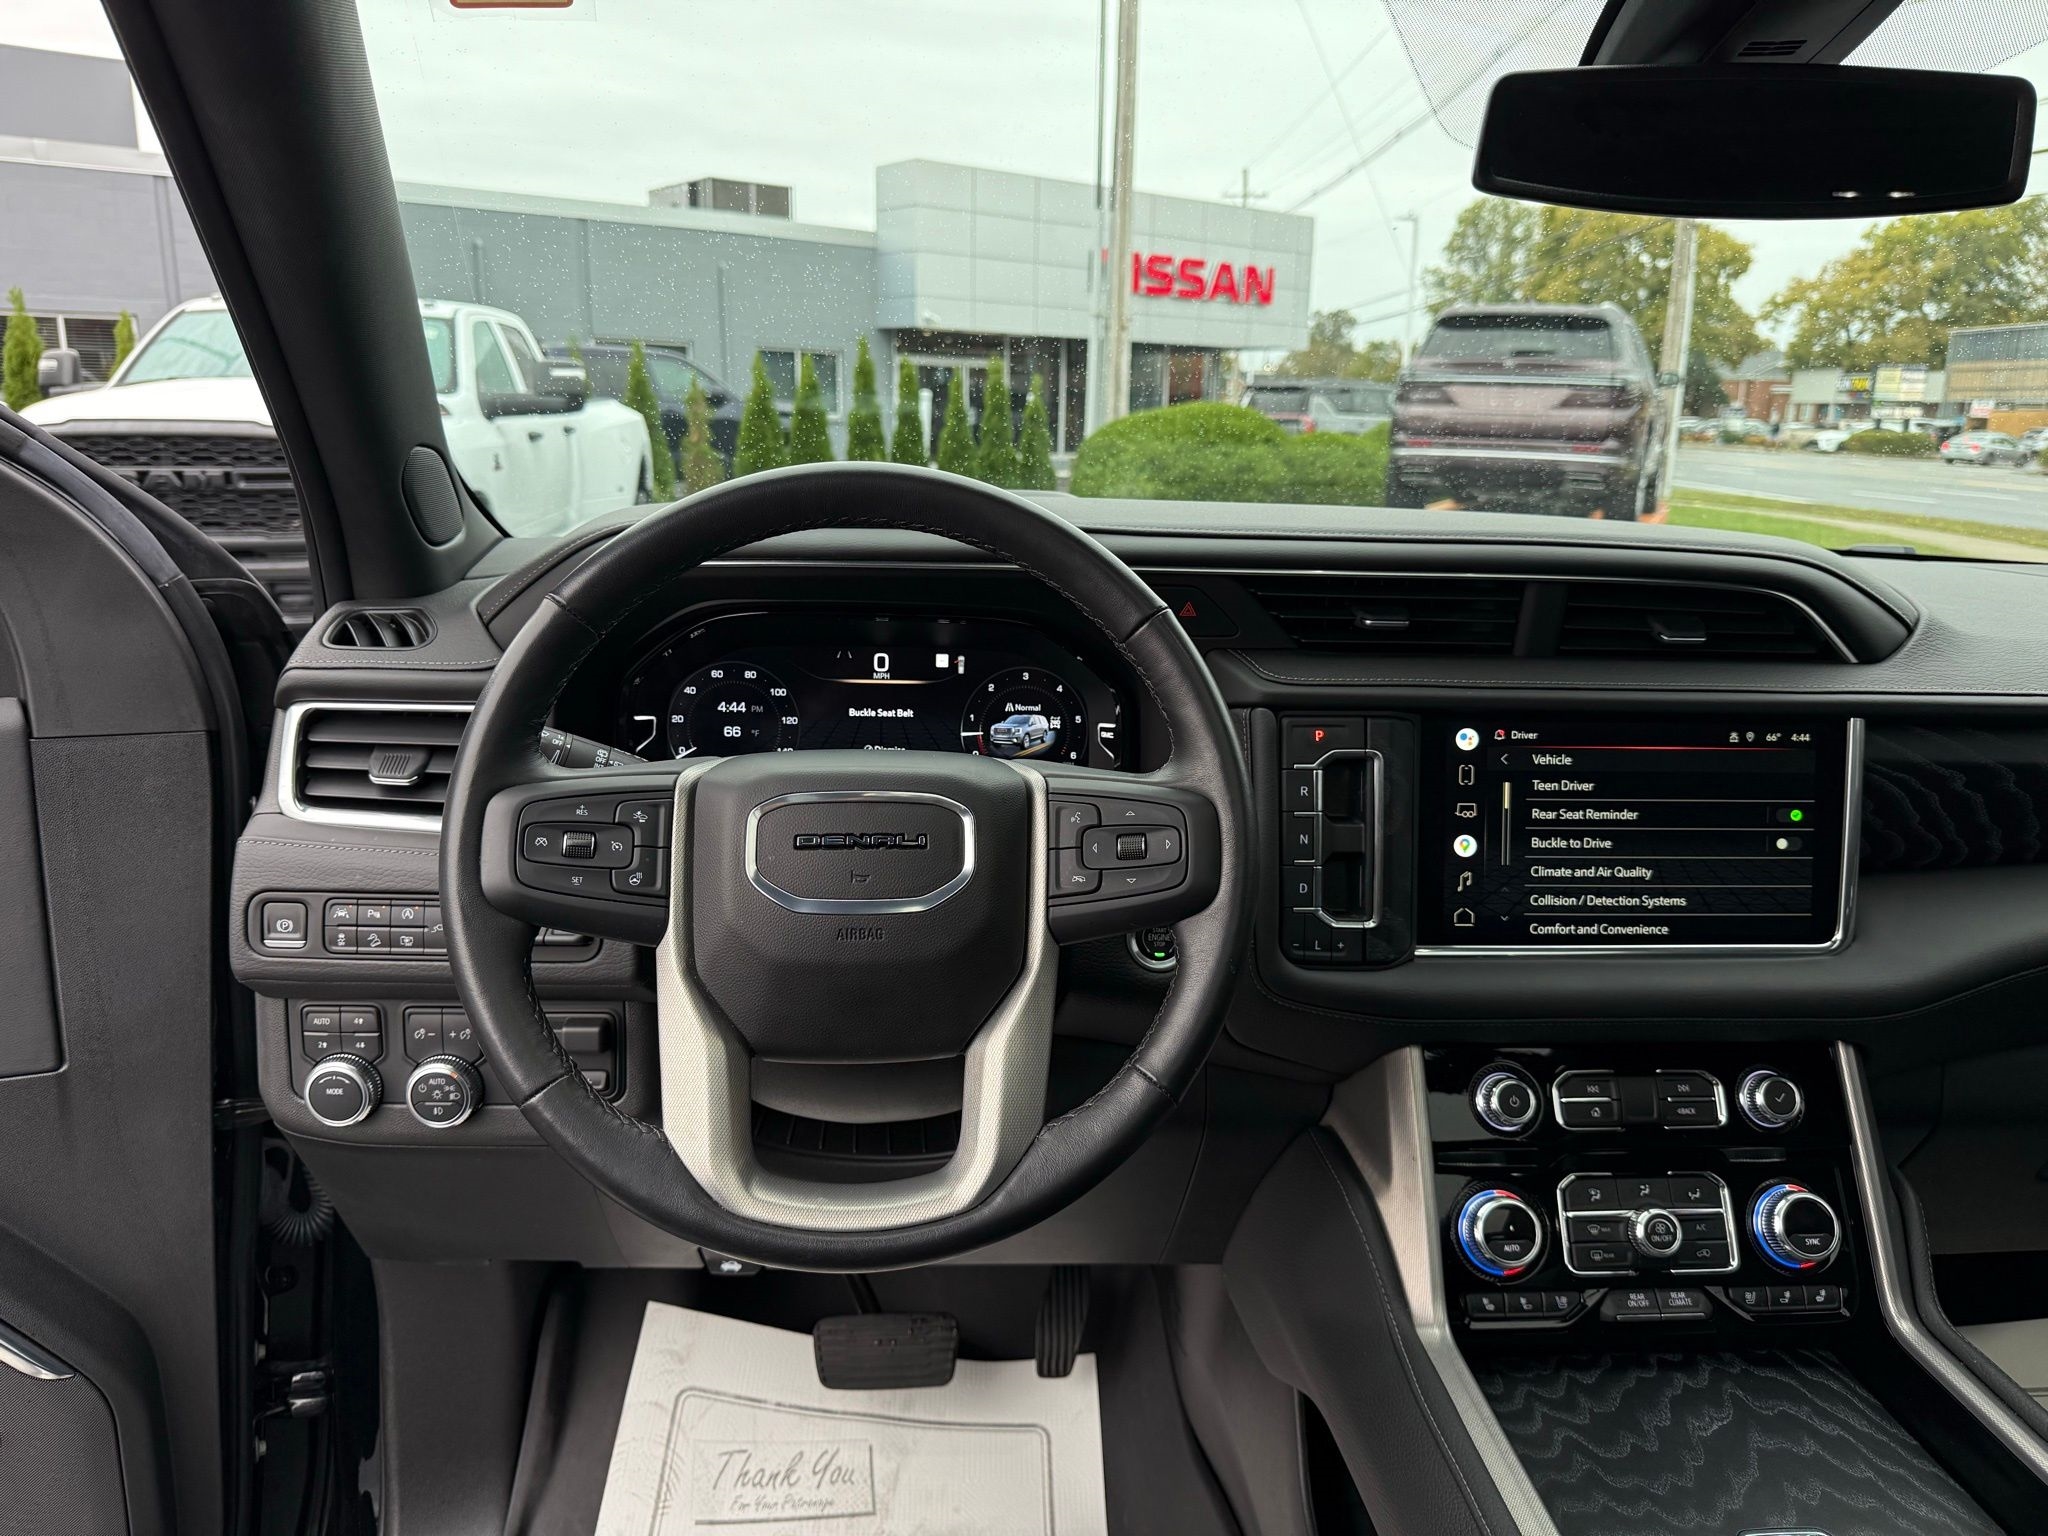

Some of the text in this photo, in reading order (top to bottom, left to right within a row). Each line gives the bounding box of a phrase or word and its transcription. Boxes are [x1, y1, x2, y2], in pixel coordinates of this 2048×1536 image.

[1102, 248, 1275, 305] ISSAN
[874, 652, 890, 672] 0
[711, 670, 724, 678] 60
[744, 670, 757, 679] 80
[873, 672, 890, 680] MPH
[1022, 672, 1029, 680] 3
[684, 686, 696, 694] 40
[770, 688, 787, 696] 100
[988, 684, 994, 692] 2
[1056, 684, 1063, 692] 4
[717, 702, 764, 713] 4:44 PM
[1015, 704, 1041, 712] Normal
[848, 708, 914, 718] Buckle Seat Belt
[970, 714, 974, 722] 1
[672, 715, 684, 723] 20
[781, 716, 798, 724] 120
[724, 726, 741, 737] 66
[1315, 730, 1324, 741] P
[1511, 730, 1538, 739] Driver
[1790, 733, 1811, 742] 4:44
[1070, 752, 1077, 760] 6
[1532, 754, 1573, 765] Vehicle
[1532, 780, 1595, 791] Teen Driver
[1300, 786, 1309, 796] R
[1532, 808, 1639, 820] Rear Seat Reminder
[795, 834, 927, 849] DENALI
[1300, 834, 1308, 844] N
[1531, 837, 1613, 848] Buckle to Drive
[1530, 866, 1653, 880] Climate and Air Quality
[1300, 883, 1307, 893] D
[1530, 894, 1577, 906] Collision
[1586, 895, 1640, 906] Detection
[1641, 895, 1687, 909] Systems
[1529, 923, 1670, 935] Comfort and Convenience
[836, 928, 884, 941] AIRBAG
[1315, 940, 1321, 950] L
[1805, 1238, 1821, 1246] SYNC
[1504, 1244, 1520, 1252] AUTO
[713, 1447, 855, 1490] Thank You
[730, 1494, 751, 1511] For
[756, 1494, 778, 1513] Your
